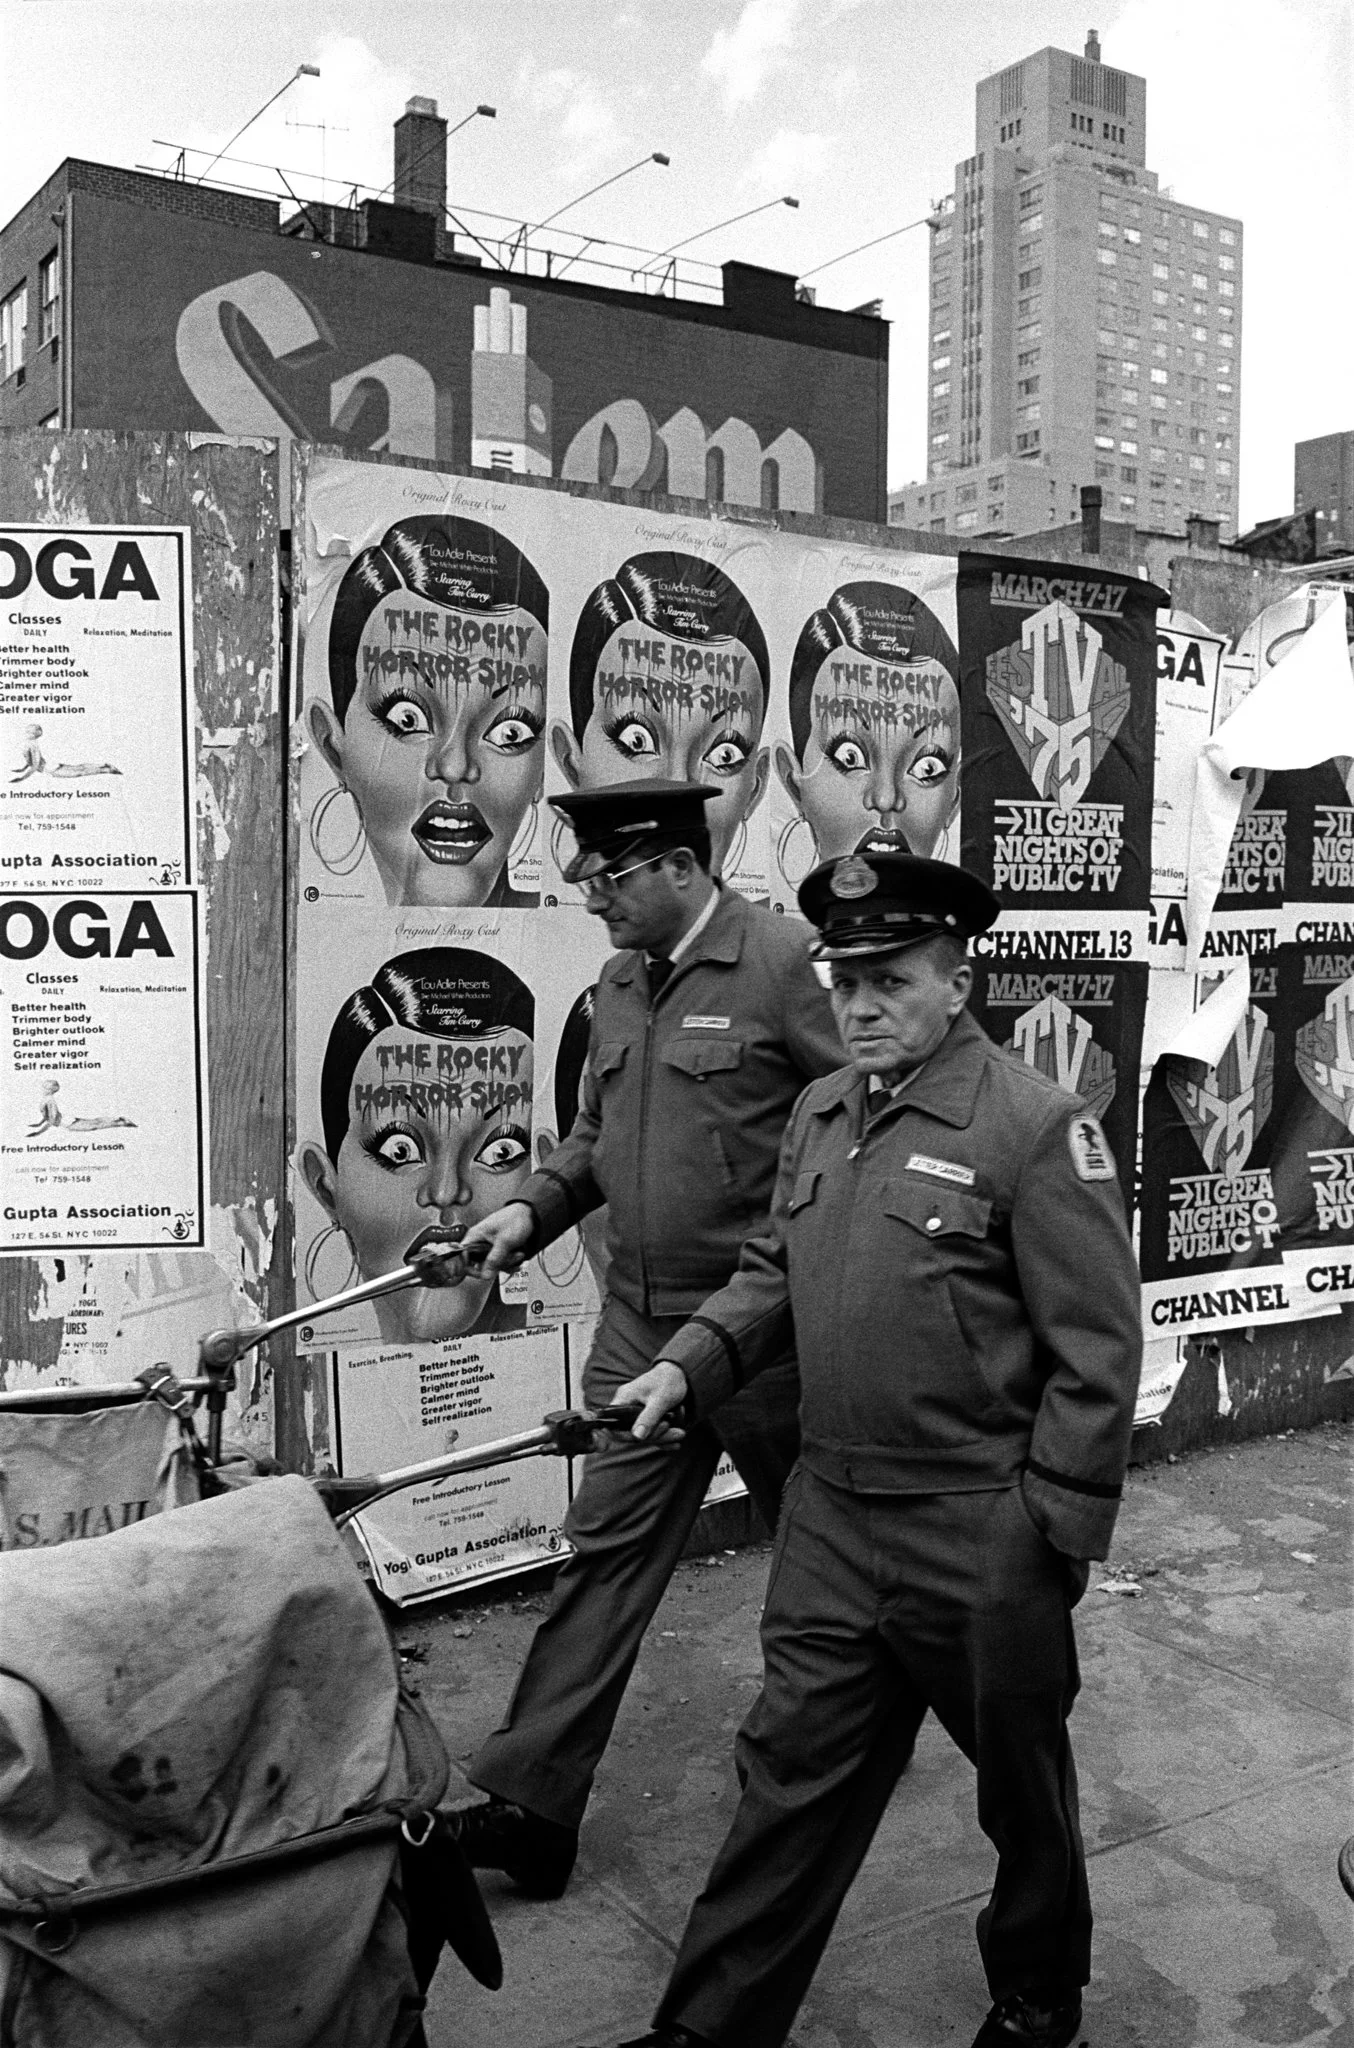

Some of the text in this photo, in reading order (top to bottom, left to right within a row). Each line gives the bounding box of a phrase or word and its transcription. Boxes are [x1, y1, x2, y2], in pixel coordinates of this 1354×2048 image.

[402, 485, 449, 503] Original
[635, 524, 674, 541] Original
[466, 550, 498, 564] Presents
[435, 573, 473, 589] Starring
[466, 588, 491, 603] Curry
[990, 571, 1128, 611] MARCH 7-17
[8, 612, 63, 625] Classes
[663, 605, 696, 619] Starring
[23, 628, 48, 637] DAILY
[83, 627, 173, 638] Relaxation, Meditation
[384, 608, 534, 655] THE ROCKY
[691, 619, 709, 633] Curry
[870, 630, 897, 643] Starring
[0, 644, 70, 654] etter health
[47, 657, 76, 668] body
[362, 645, 472, 688] HORROR
[618, 638, 746, 686] THE ROCKY
[45, 669, 90, 679] outlook
[40, 681, 70, 690] mind
[599, 671, 694, 712] HORROR
[831, 662, 944, 706] THE ROCKY
[43, 693, 73, 704] vigor
[0, 705, 86, 715] Self realization
[815, 694, 898, 732] HORROR
[10, 790, 74, 800] Introductory
[76, 790, 110, 799] Lesson
[1023, 806, 1123, 838] 11 GREAT
[994, 835, 1123, 865] NIGHTS OF
[0, 853, 158, 870] upta Association
[513, 872, 540, 881] Richard
[992, 863, 1121, 892] PUBLIC TV
[395, 923, 501, 938] Original Roxy Cast
[972, 929, 1132, 961] CHANNEL 13
[26, 971, 79, 985] Classes
[420, 977, 490, 990] Lou Adler Presents
[41, 987, 65, 995] DAILY
[100, 984, 187, 994] Relaxation, Meditation
[987, 973, 1115, 1000] MARCH 7-17
[12, 1001, 87, 1013] Better health
[426, 1003, 464, 1018] Starring
[12, 1013, 92, 1025] Trimmer body
[438, 1014, 482, 1029] Tim Curry
[13, 1024, 106, 1037] Brighter outlook
[13, 1037, 86, 1048] Calmer mind
[14, 1049, 89, 1060] Greater vigor
[376, 1043, 527, 1079] THE ROCKY
[14, 1060, 102, 1071] Self realization
[354, 1082, 464, 1118] HORROR
[1, 1142, 125, 1154] Free Introductory Lesson
[53, 1175, 91, 1184] 759-1548
[1194, 1180, 1212, 1207] 11
[3, 1203, 172, 1222] Gupta Association
[1168, 1202, 1252, 1236] NIGHTS
[67, 1229, 89, 1239] NYC
[92, 1228, 118, 1238] 10022
[1167, 1227, 1252, 1262] PUBLIC
[1151, 1283, 1290, 1326] CHANNEL
[443, 1342, 463, 1353] DAILY
[348, 1350, 414, 1369] Exercise, Breathing,
[419, 1353, 480, 1373] Better health
[419, 1363, 485, 1384] Trimmer body
[420, 1372, 496, 1395] Brighter outlook
[420, 1385, 480, 1406] Calmer mind
[421, 1396, 483, 1416] Greater vigor
[421, 1405, 492, 1427] Self realization
[412, 1476, 511, 1506] Free Introductory Lesson
[383, 1523, 547, 1576] Yogi Gupta Association
